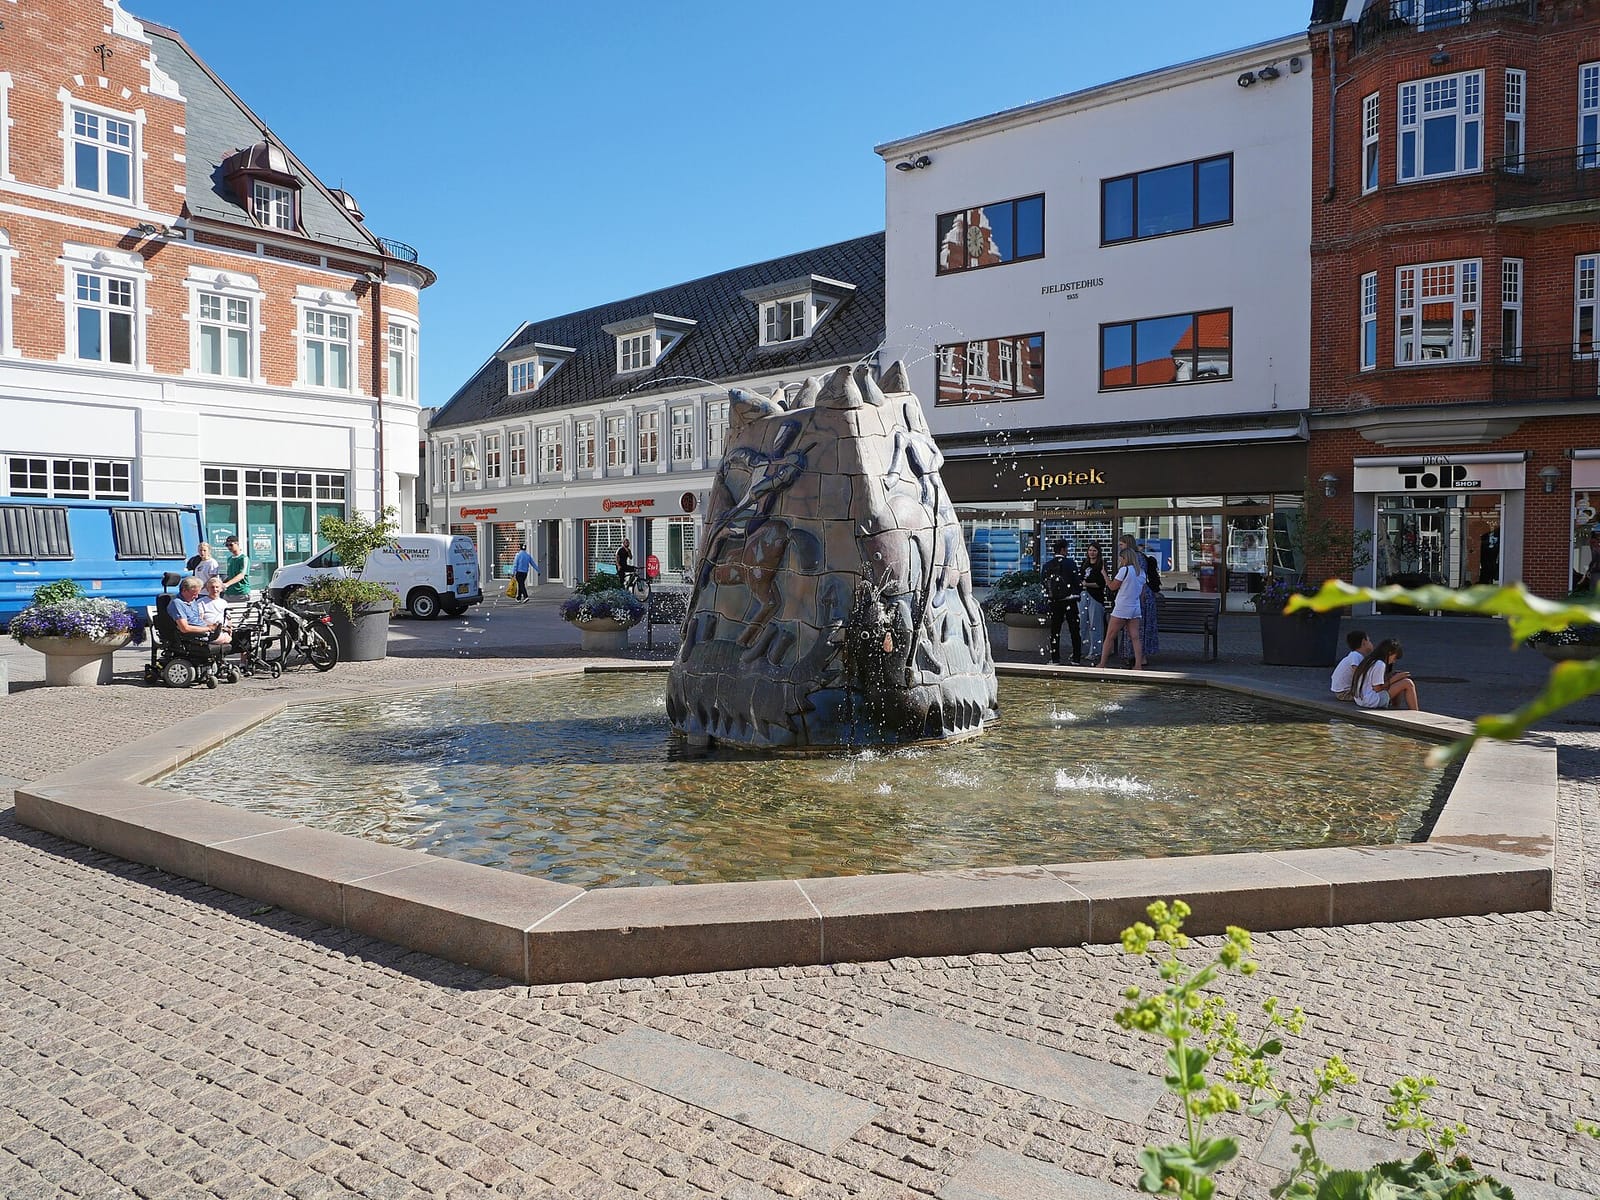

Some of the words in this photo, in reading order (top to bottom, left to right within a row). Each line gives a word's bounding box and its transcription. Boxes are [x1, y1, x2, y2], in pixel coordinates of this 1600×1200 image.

[1041, 278, 1104, 295] FJELDSTEDHUS
[1422, 455, 1450, 465] DEGN
[1026, 468, 1105, 491] apotek
